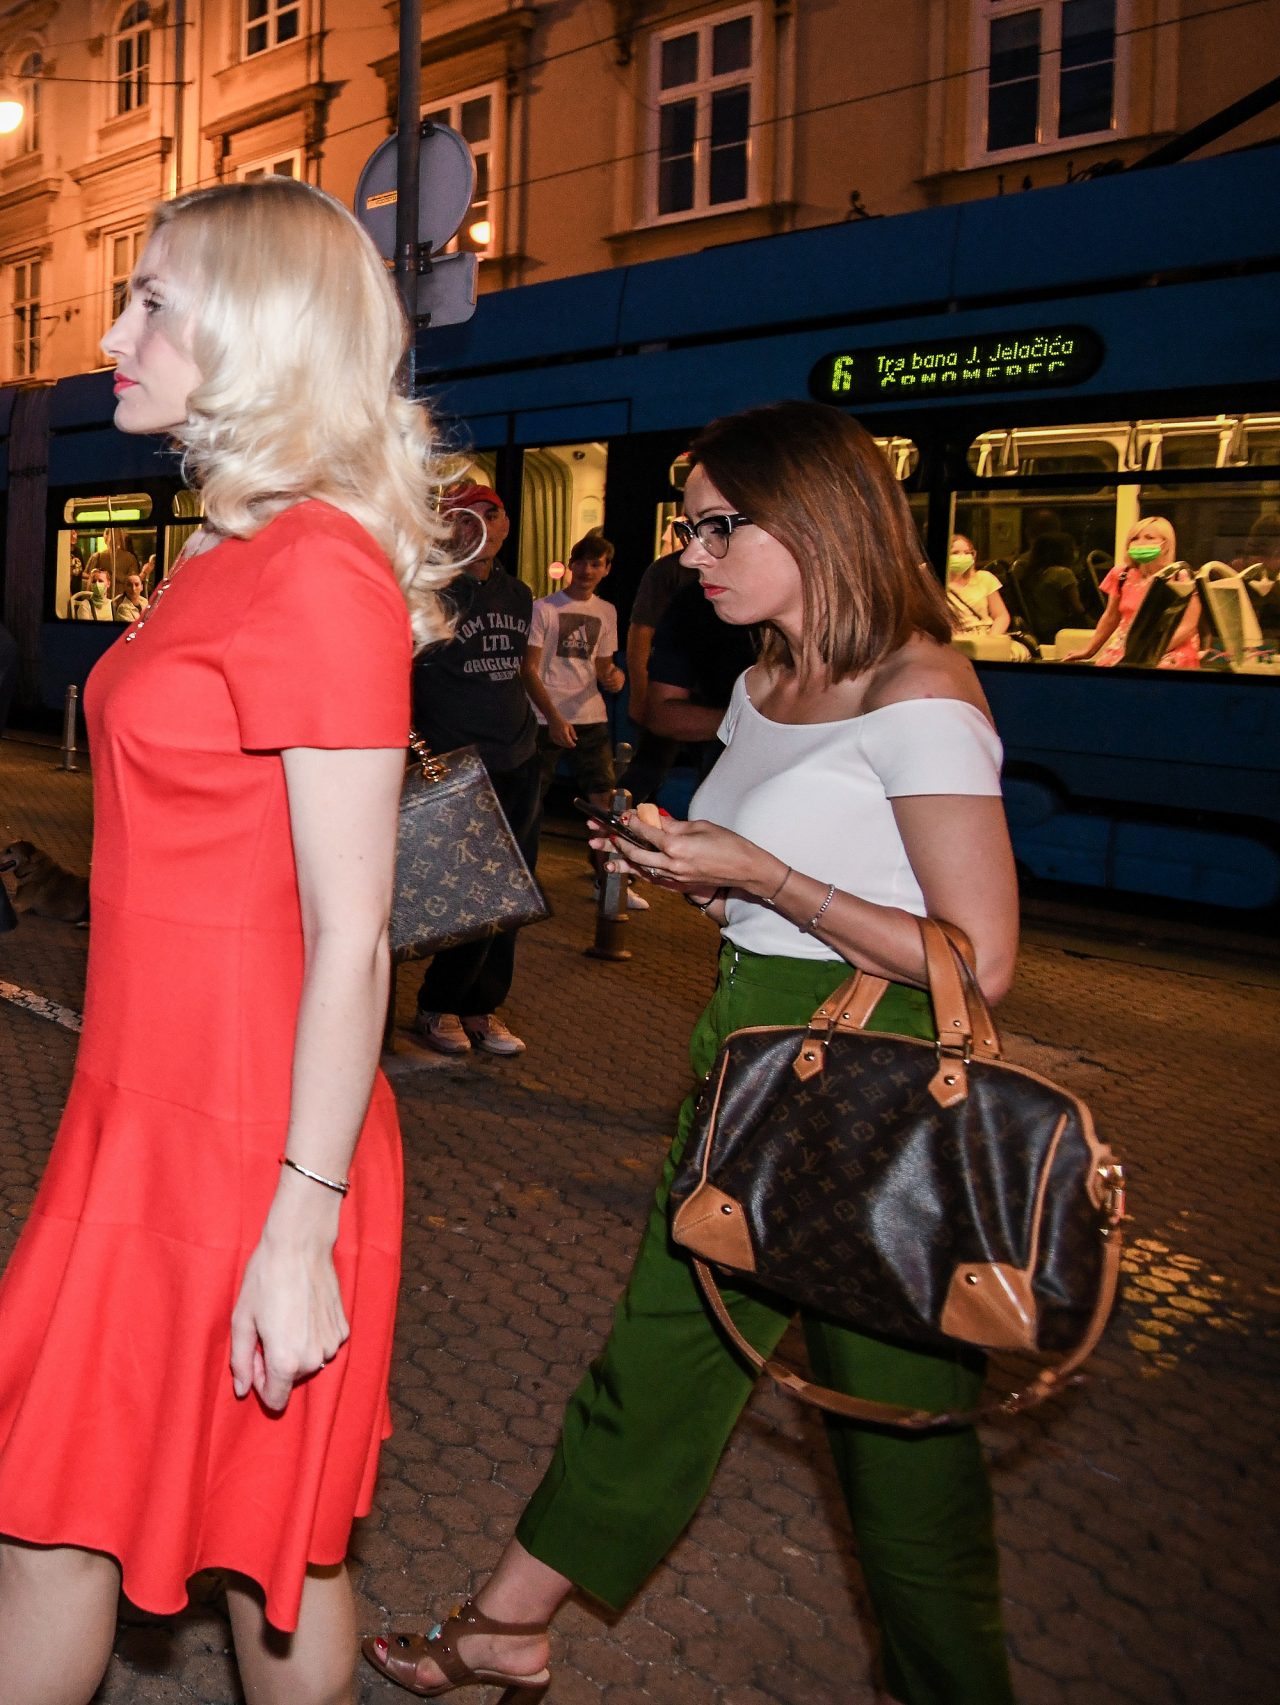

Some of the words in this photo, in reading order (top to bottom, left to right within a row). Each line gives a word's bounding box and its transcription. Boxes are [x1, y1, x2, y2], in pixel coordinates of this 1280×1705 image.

[832, 356, 853, 391] 6
[877, 355, 905, 372] Trg
[912, 352, 957, 370] bana
[966, 346, 980, 363] J.
[989, 335, 1073, 361] Jelačića
[455, 616, 485, 644] TOM
[483, 635, 514, 652] LTD.
